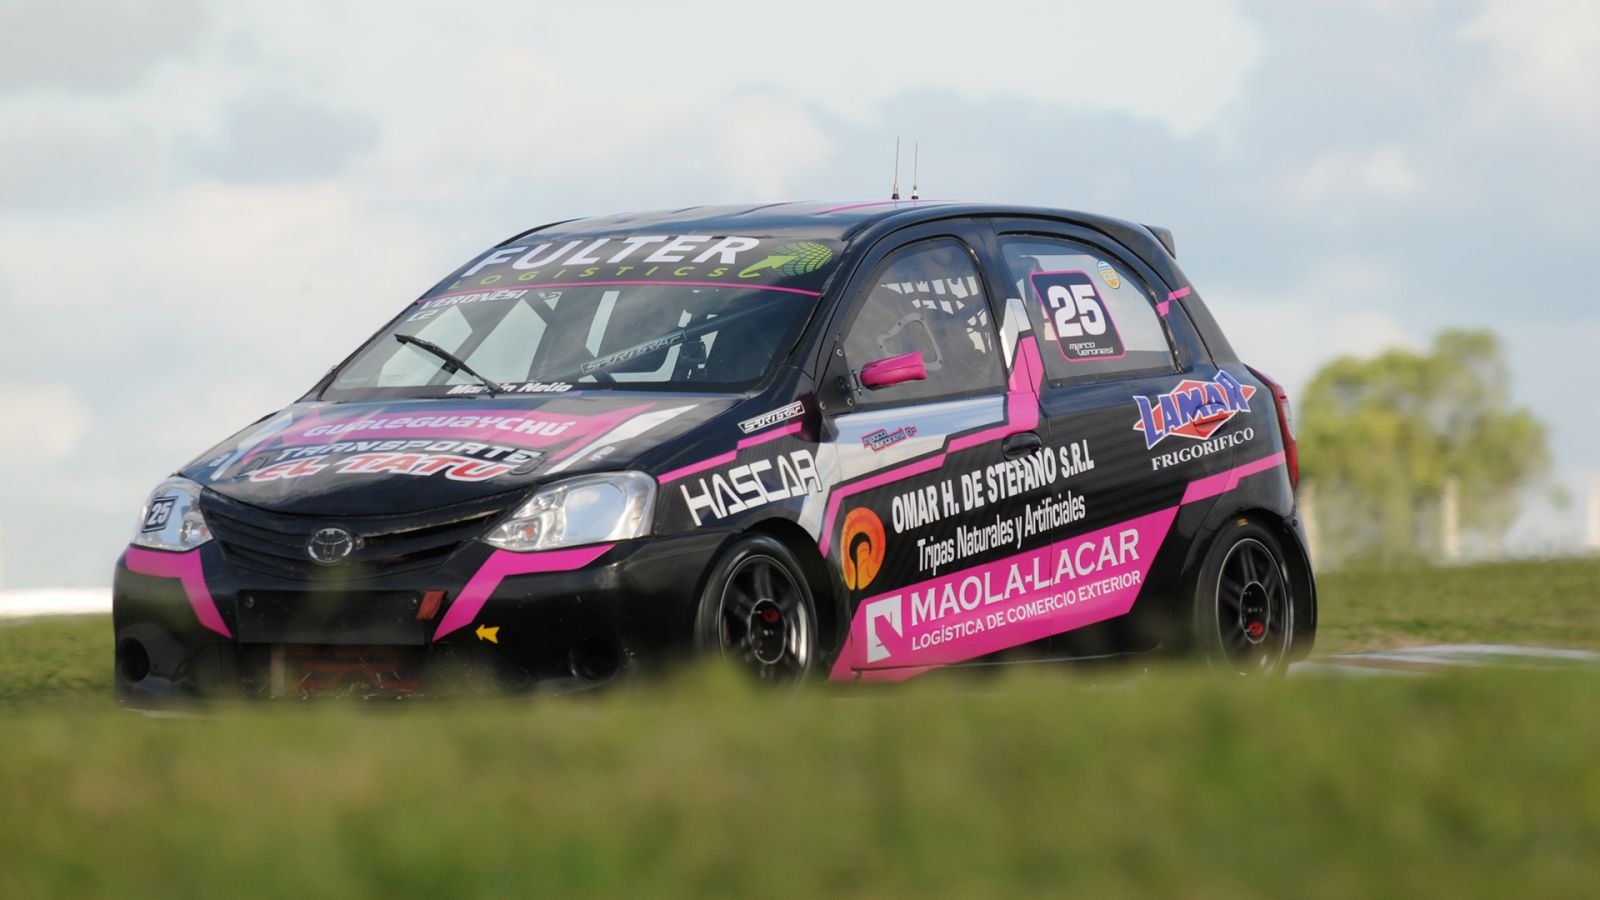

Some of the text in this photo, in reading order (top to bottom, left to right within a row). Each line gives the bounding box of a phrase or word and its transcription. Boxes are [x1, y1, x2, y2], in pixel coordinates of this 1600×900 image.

[447, 265, 729, 290] LOGISTICS
[460, 235, 760, 278] FULTER
[1046, 284, 1106, 337] 25
[1132, 369, 1251, 450] LAMAR
[275, 440, 542, 464] TRANSPORTE
[335, 452, 519, 482] TATU
[1151, 427, 1255, 471] FRIGORIFICO
[680, 449, 823, 526] HASCAR
[891, 485, 940, 534] OMAR
[941, 480, 959, 518] H.
[961, 470, 985, 511] DE
[1060, 439, 1095, 479] S.R.L
[147, 501, 173, 526] 25
[917, 491, 1086, 576] Tripas Naturales y Artificiales
[911, 528, 1141, 627] MAOLA-LACAR
[986, 609, 1007, 631] DE
[1006, 590, 1077, 624] COMERCIO
[1079, 569, 1142, 604] EXTERIOR
